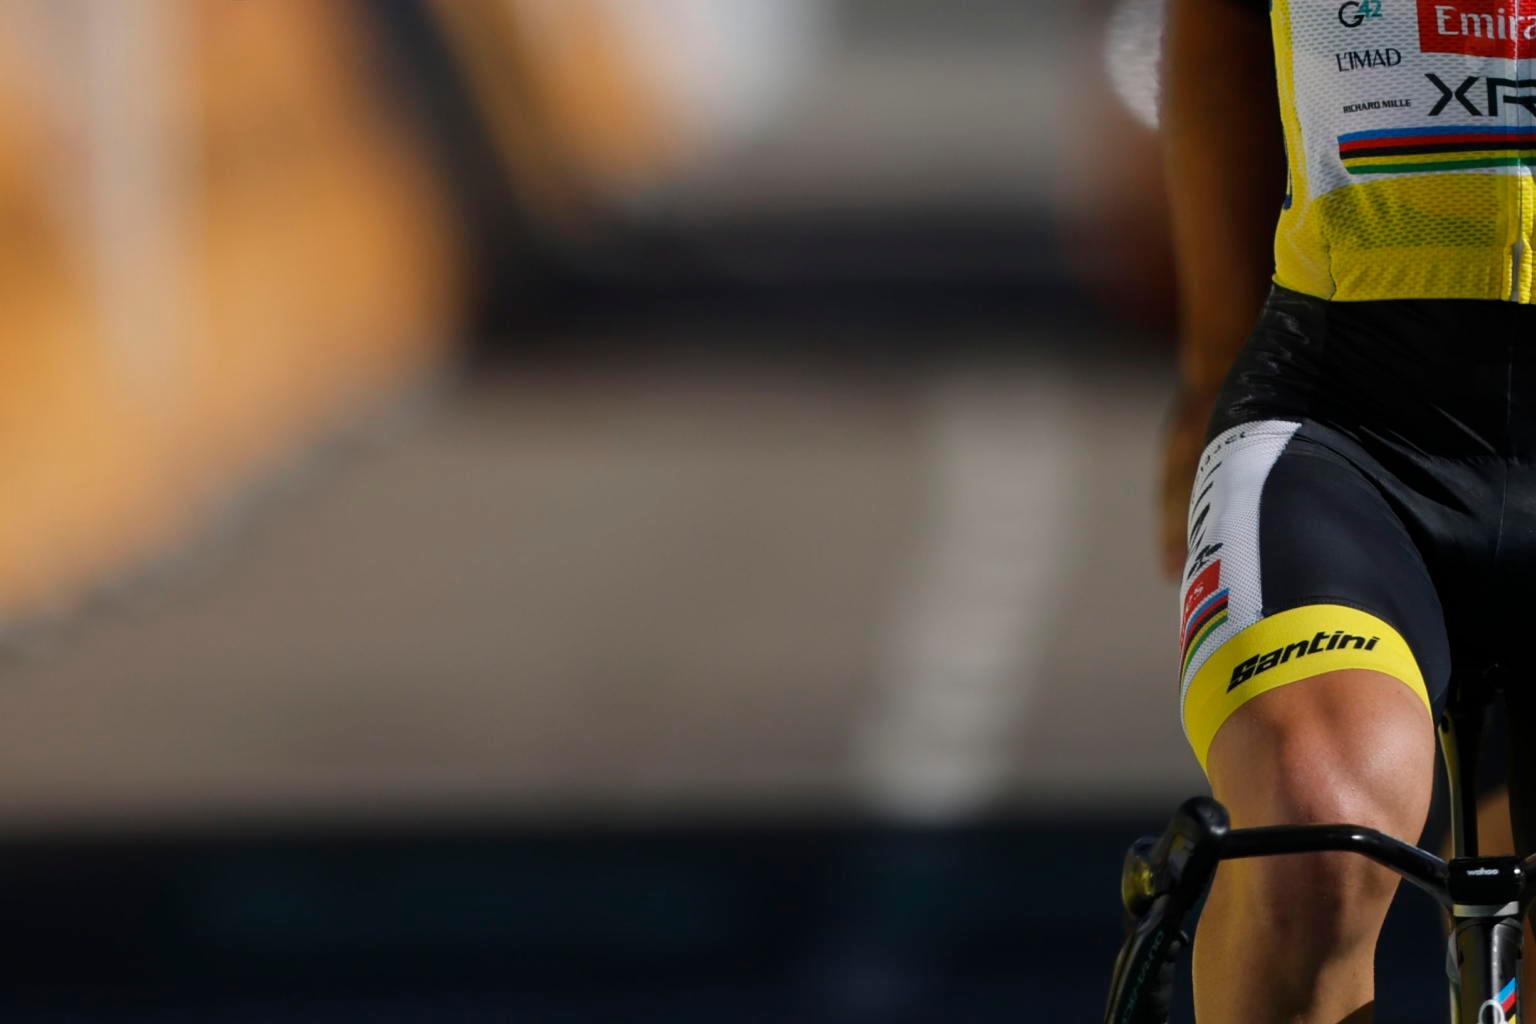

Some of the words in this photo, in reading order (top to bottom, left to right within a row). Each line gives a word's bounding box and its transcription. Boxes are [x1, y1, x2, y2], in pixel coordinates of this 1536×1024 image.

[1338, 0, 1383, 28] G42
[1343, 101, 1381, 114] RICHARD
[1381, 98, 1412, 110] MILLE
[1226, 631, 1382, 694] Santini
[1466, 868, 1500, 877] wahoo
